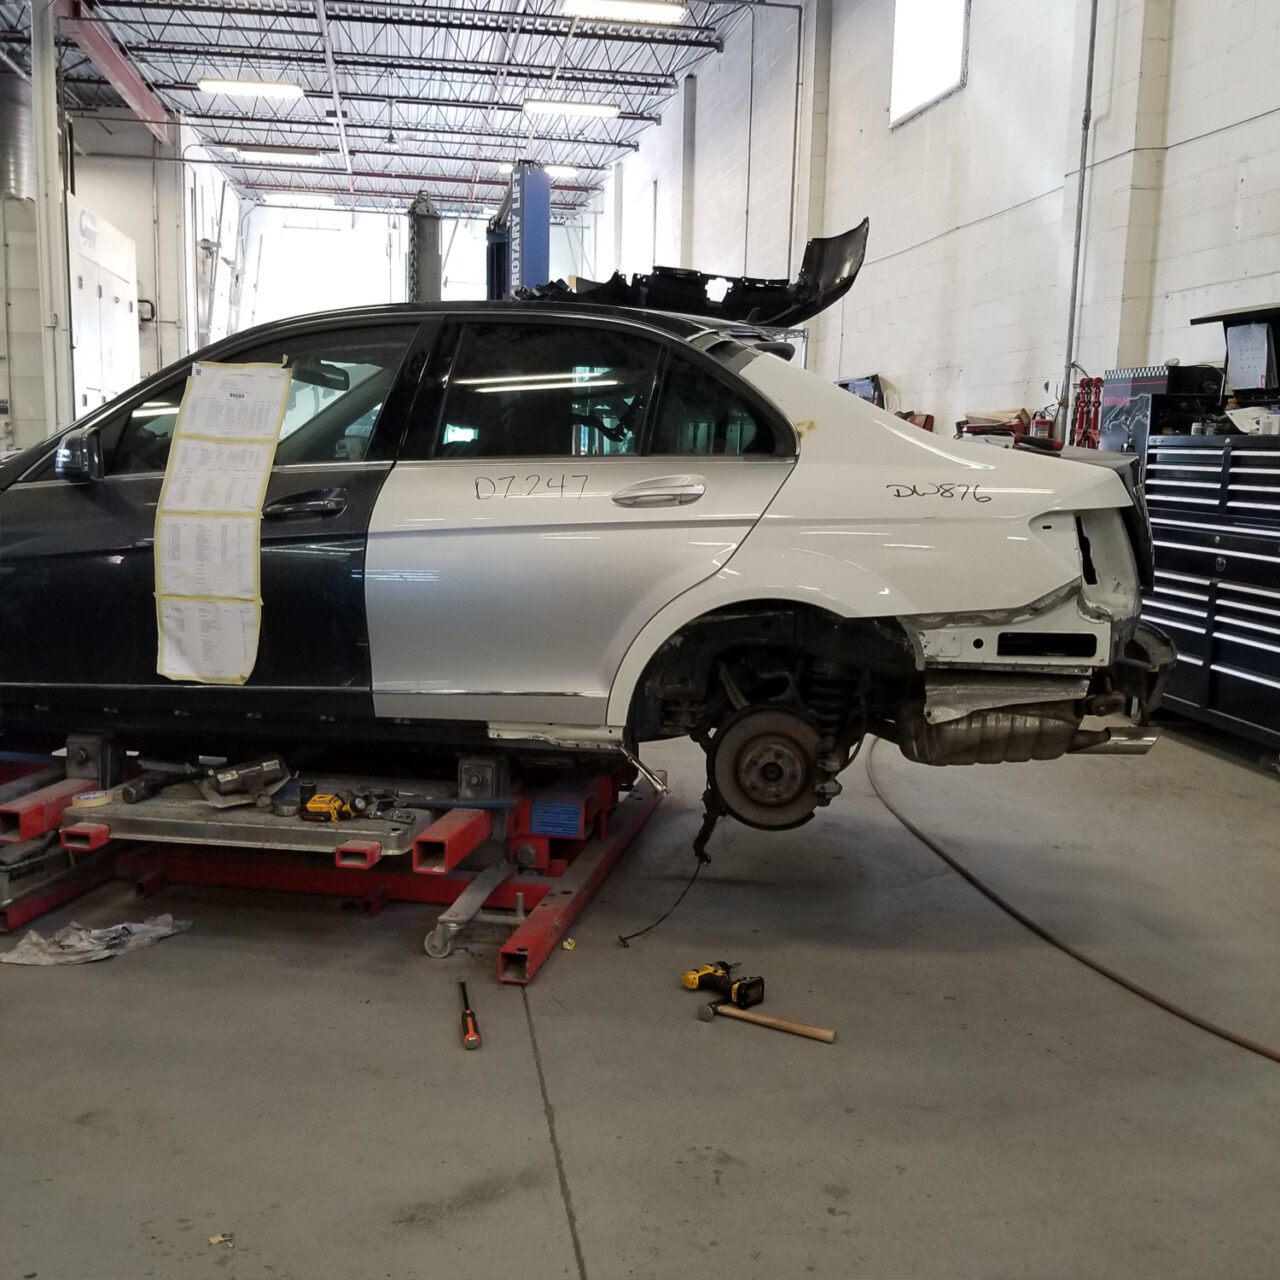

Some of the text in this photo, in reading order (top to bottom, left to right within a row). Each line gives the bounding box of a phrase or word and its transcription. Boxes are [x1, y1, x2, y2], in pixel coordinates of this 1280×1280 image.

[511, 173, 520, 286] ROTARY LIFT
[886, 482, 992, 503] DW876
